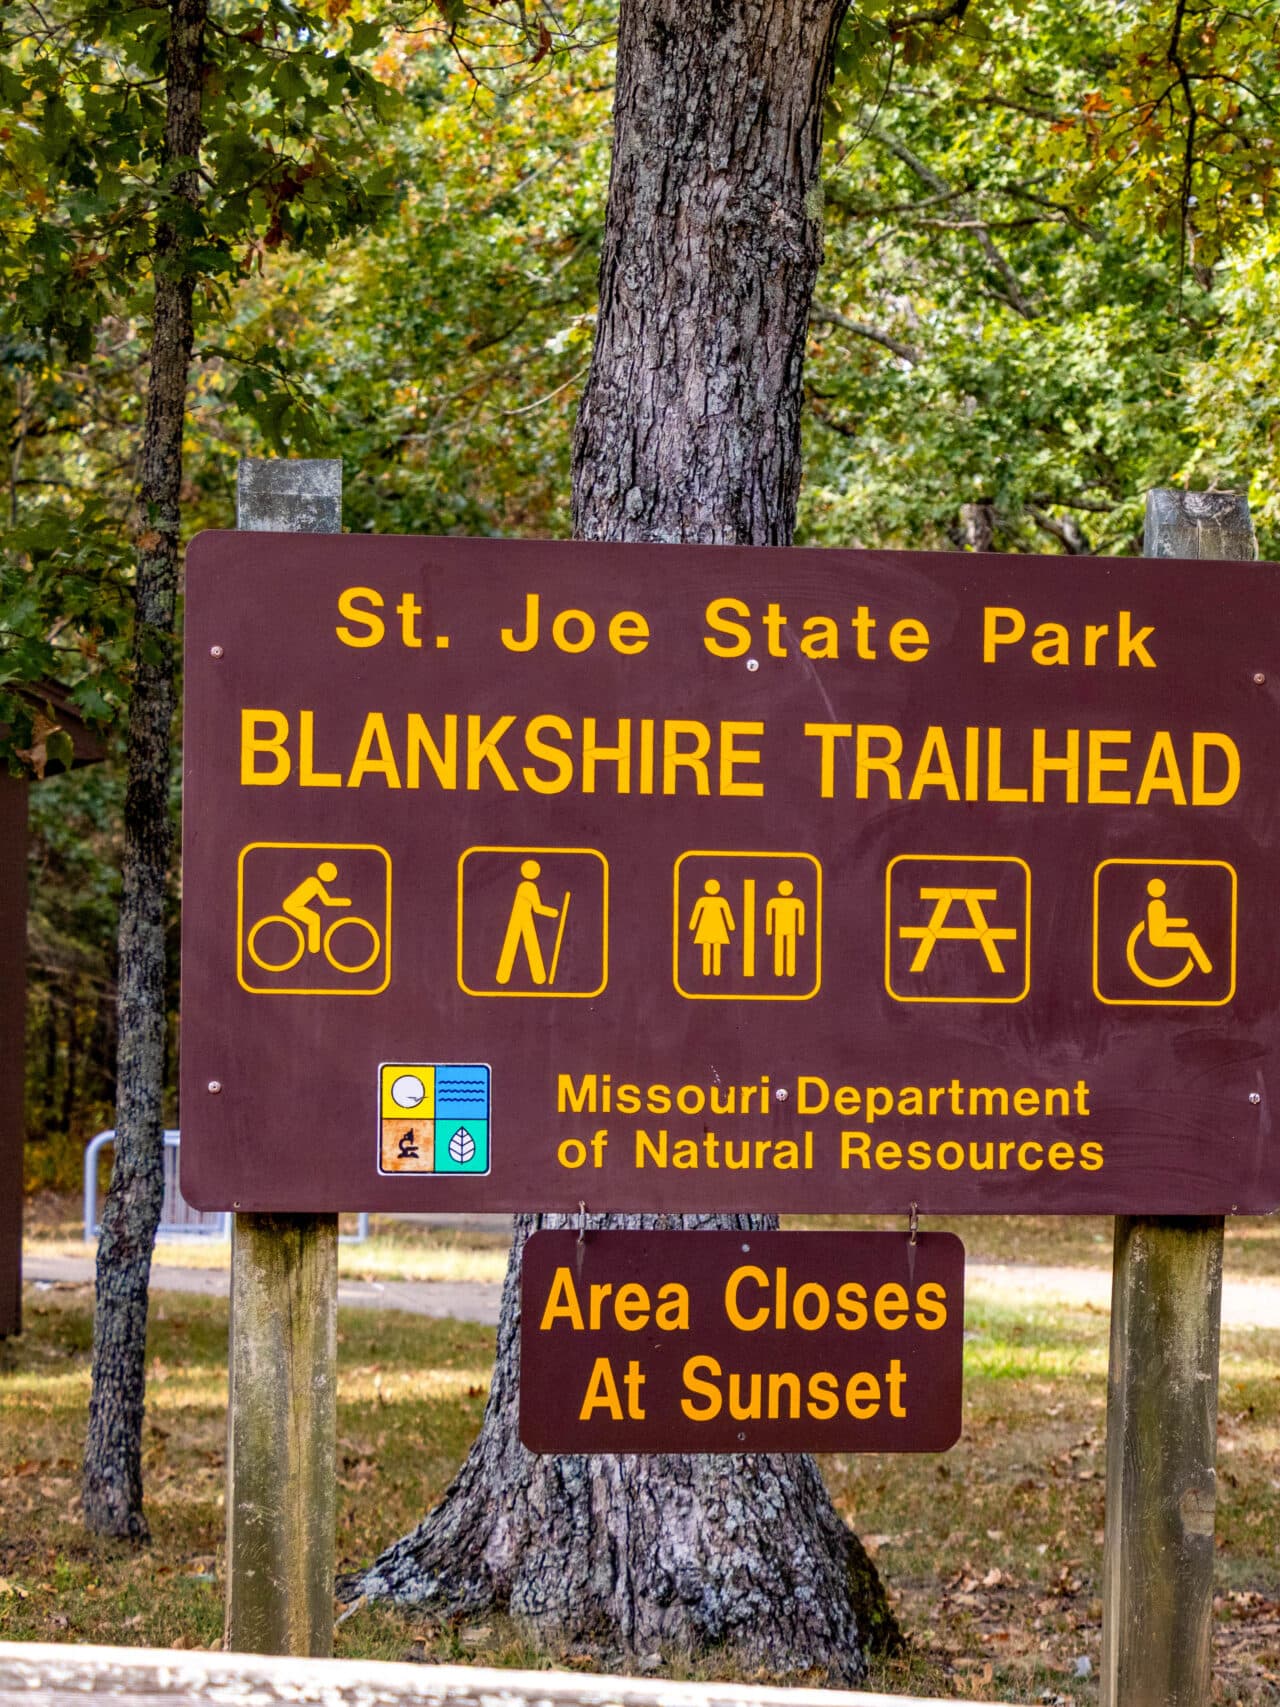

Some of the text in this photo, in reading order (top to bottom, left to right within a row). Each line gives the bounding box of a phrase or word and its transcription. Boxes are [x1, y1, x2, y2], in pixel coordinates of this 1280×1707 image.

[336, 587, 1156, 667] St. Joe State Park
[241, 709, 1240, 806] BLANKSHIRE TRAILHEAD
[558, 1074, 1090, 1123] Missouri Department
[558, 1129, 1103, 1171] of Natural Resources
[540, 1266, 947, 1331] Area Closes
[579, 1355, 906, 1421] At Sunset
